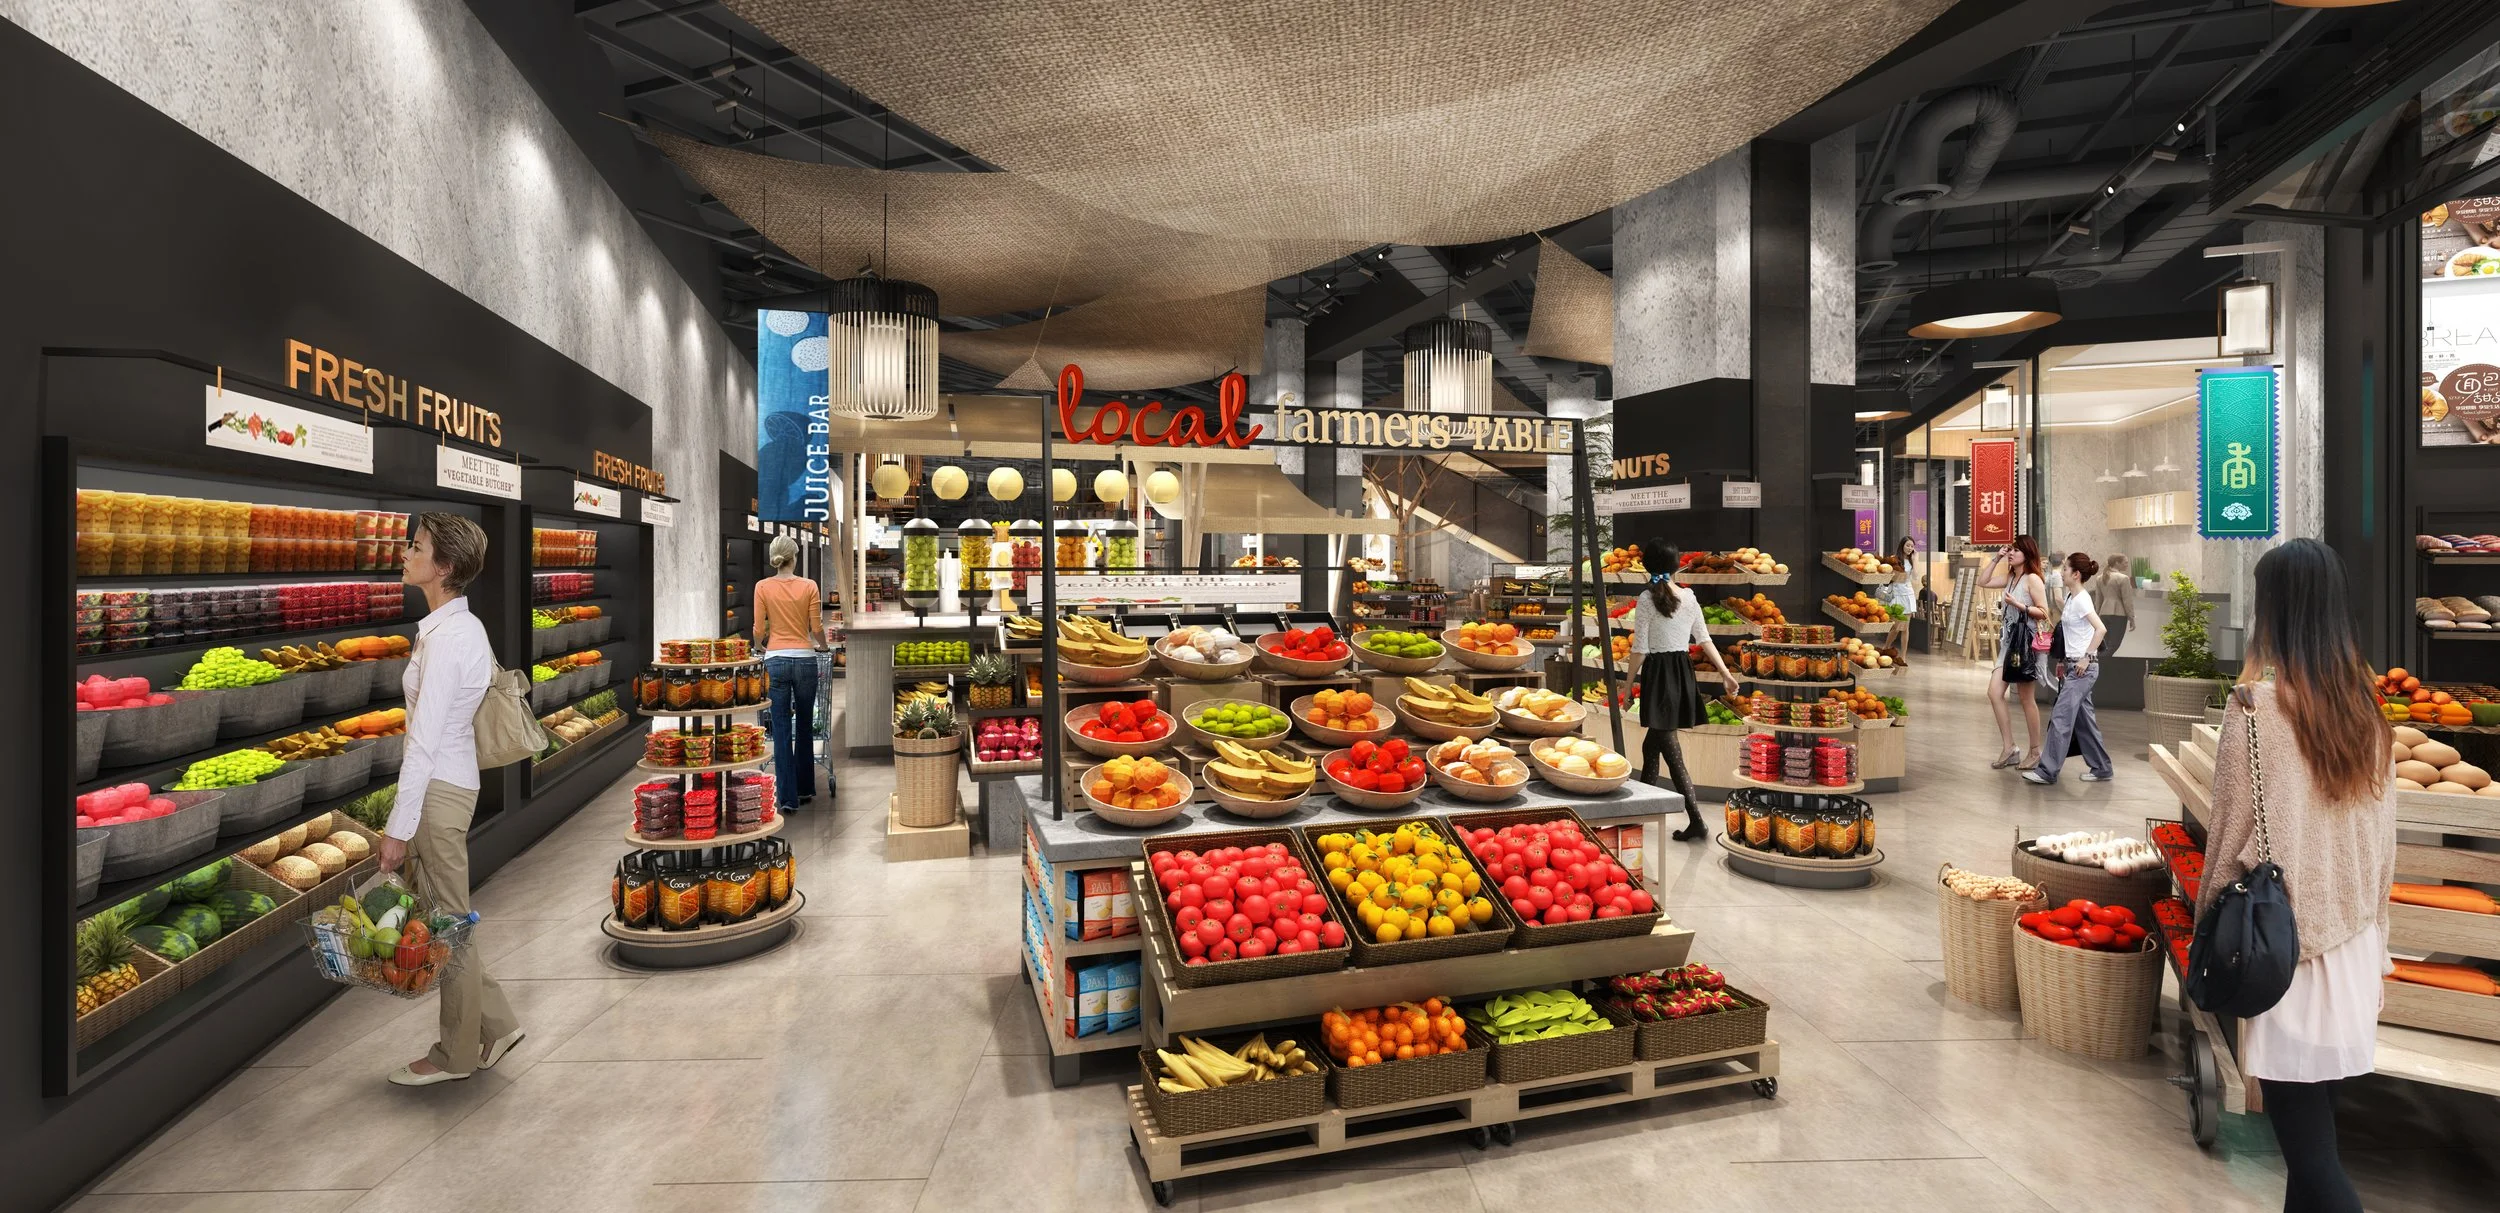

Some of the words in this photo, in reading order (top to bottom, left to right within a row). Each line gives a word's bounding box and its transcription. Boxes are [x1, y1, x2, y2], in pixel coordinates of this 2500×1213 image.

[285, 338, 407, 422] FRESH
[417, 385, 502, 448] FRUITS
[1058, 363, 1263, 448] local
[1274, 392, 1451, 449] farmers
[1468, 416, 1573, 454] TABLE
[808, 395, 830, 435] BAR
[461, 455, 483, 473] MEET
[484, 461, 500, 477] THE
[593, 450, 632, 486] FRESH
[635, 464, 666, 496] FRUITS
[804, 444, 830, 521] JUICE
[1613, 453, 1671, 480] NUTS
[2222, 442, 2256, 489] 香
[1630, 491, 1652, 500] MEET
[1652, 490, 1669, 498] THE
[1980, 490, 2005, 515] 甜
